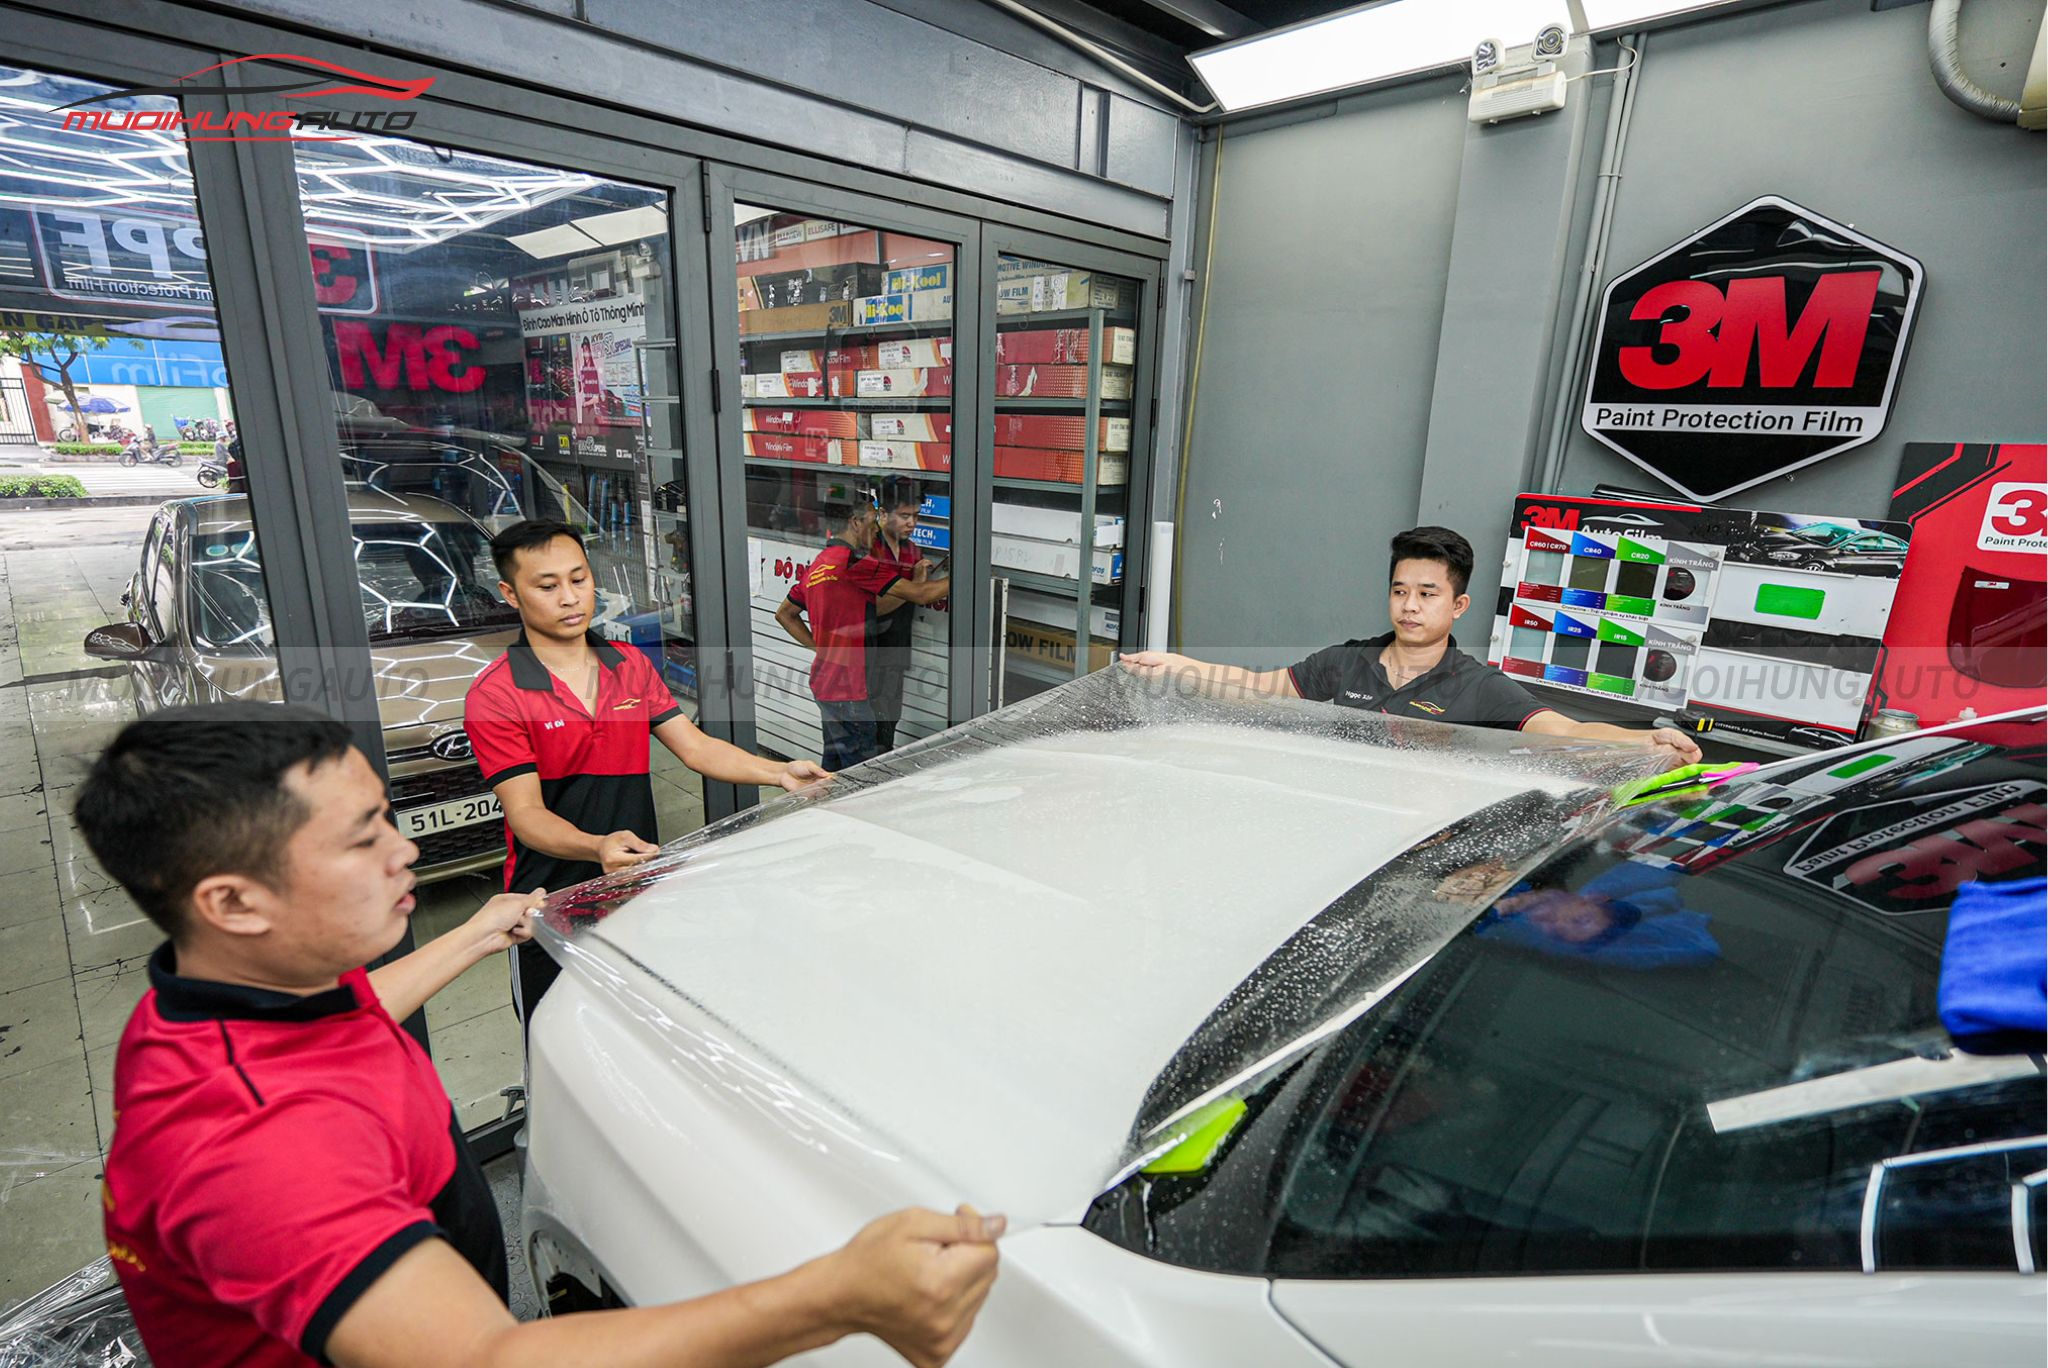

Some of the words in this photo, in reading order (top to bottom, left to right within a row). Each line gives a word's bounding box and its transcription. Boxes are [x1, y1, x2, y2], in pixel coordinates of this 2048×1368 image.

[808, 222, 836, 236] ELLISAFE
[537, 316, 550, 329] Cao
[600, 304, 627, 324] Thông
[1619, 270, 1884, 390] 3M
[1596, 407, 1655, 428] Paint
[1662, 407, 1794, 431] Protection
[1802, 410, 1864, 432] Film
[1521, 505, 1580, 531] 3M
[1991, 489, 2047, 537] 3
[1985, 536, 2014, 547] Paint
[1584, 547, 1602, 555] CR40
[1631, 552, 1650, 560] CR20
[1669, 556, 1688, 566] KÍNH
[1688, 556, 1714, 568] TRẮNG
[1524, 618, 1538, 626] IR50
[1648, 638, 1666, 648] KÍNH
[1666, 640, 1692, 651] TRẮNG
[1764, 730, 1786, 740] Reserved
[410, 799, 504, 832] 51L-204
